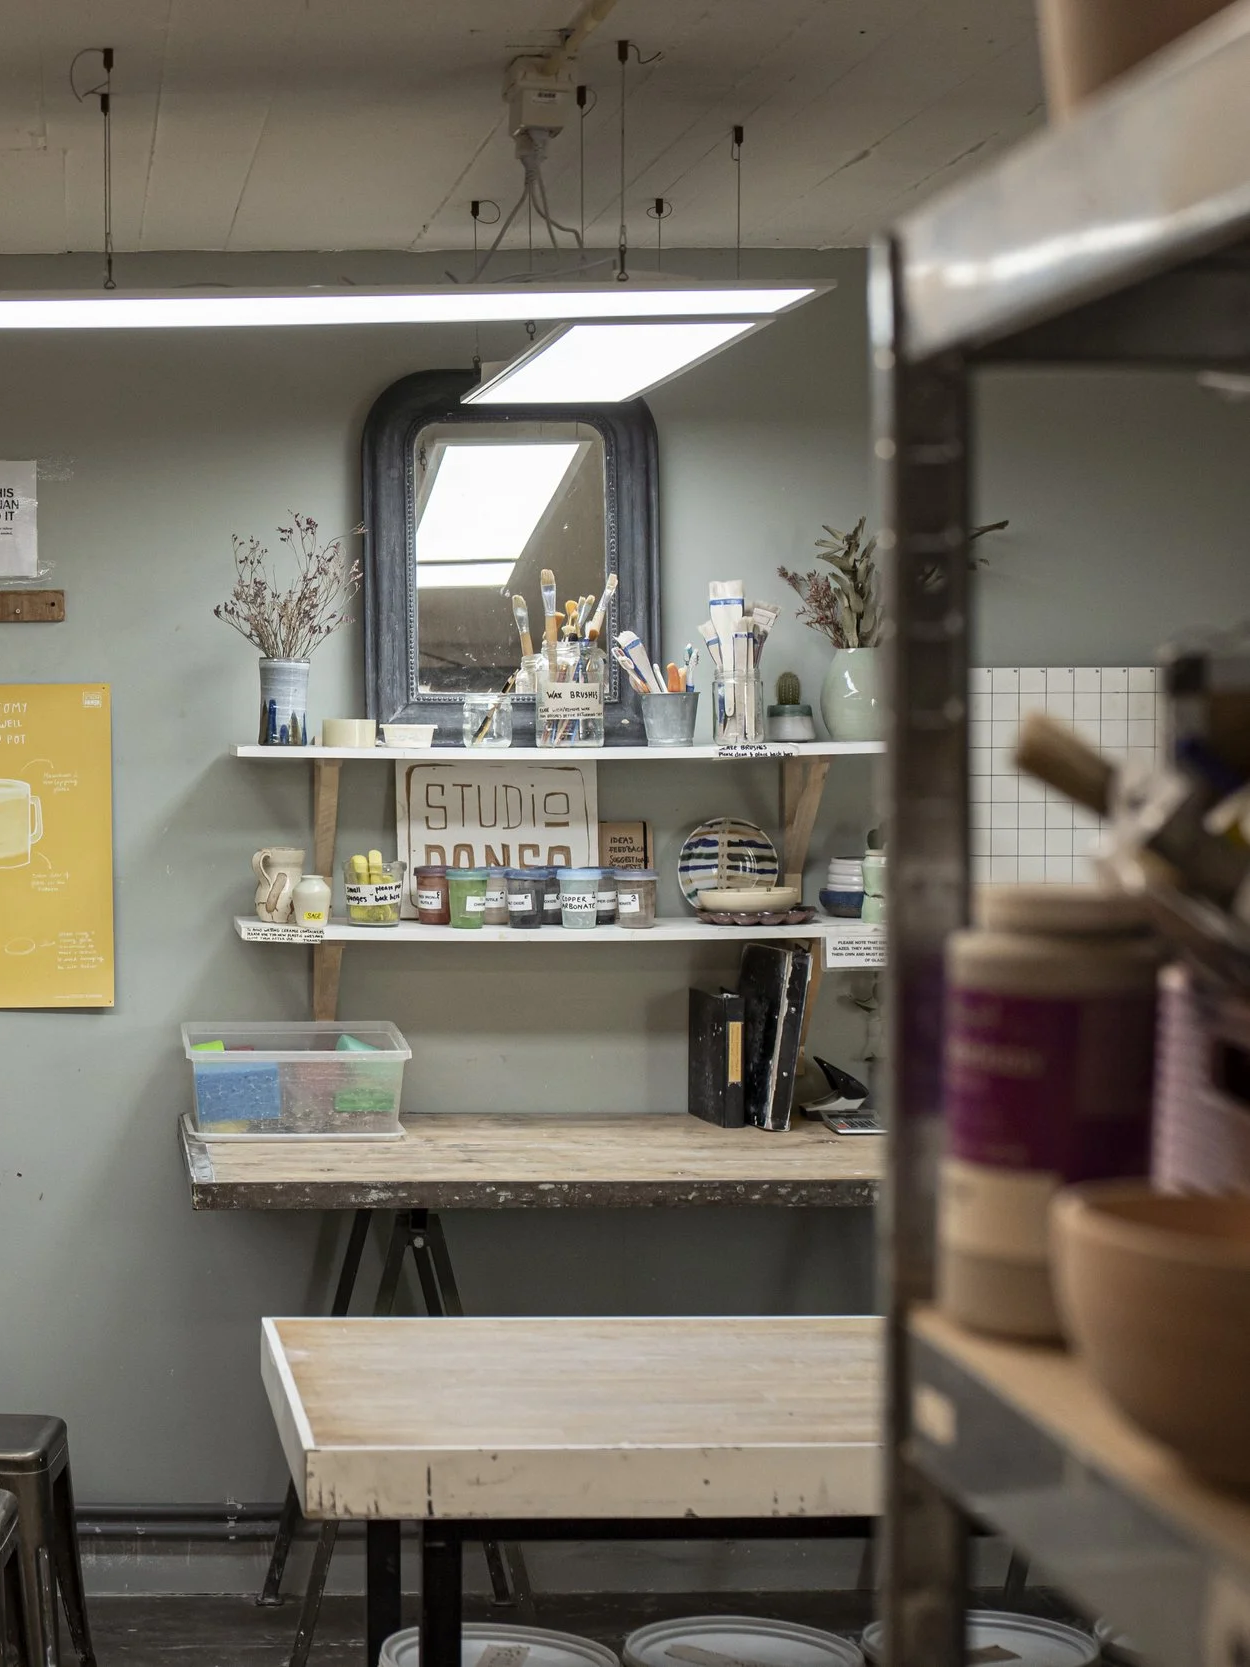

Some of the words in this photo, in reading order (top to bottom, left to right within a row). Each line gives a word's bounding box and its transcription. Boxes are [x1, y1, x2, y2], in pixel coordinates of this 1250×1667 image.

[5, 511, 15, 521] IT
[6, 734, 26, 745] POT
[610, 836, 634, 844] IDEAS
[561, 895, 587, 903] COPPER
